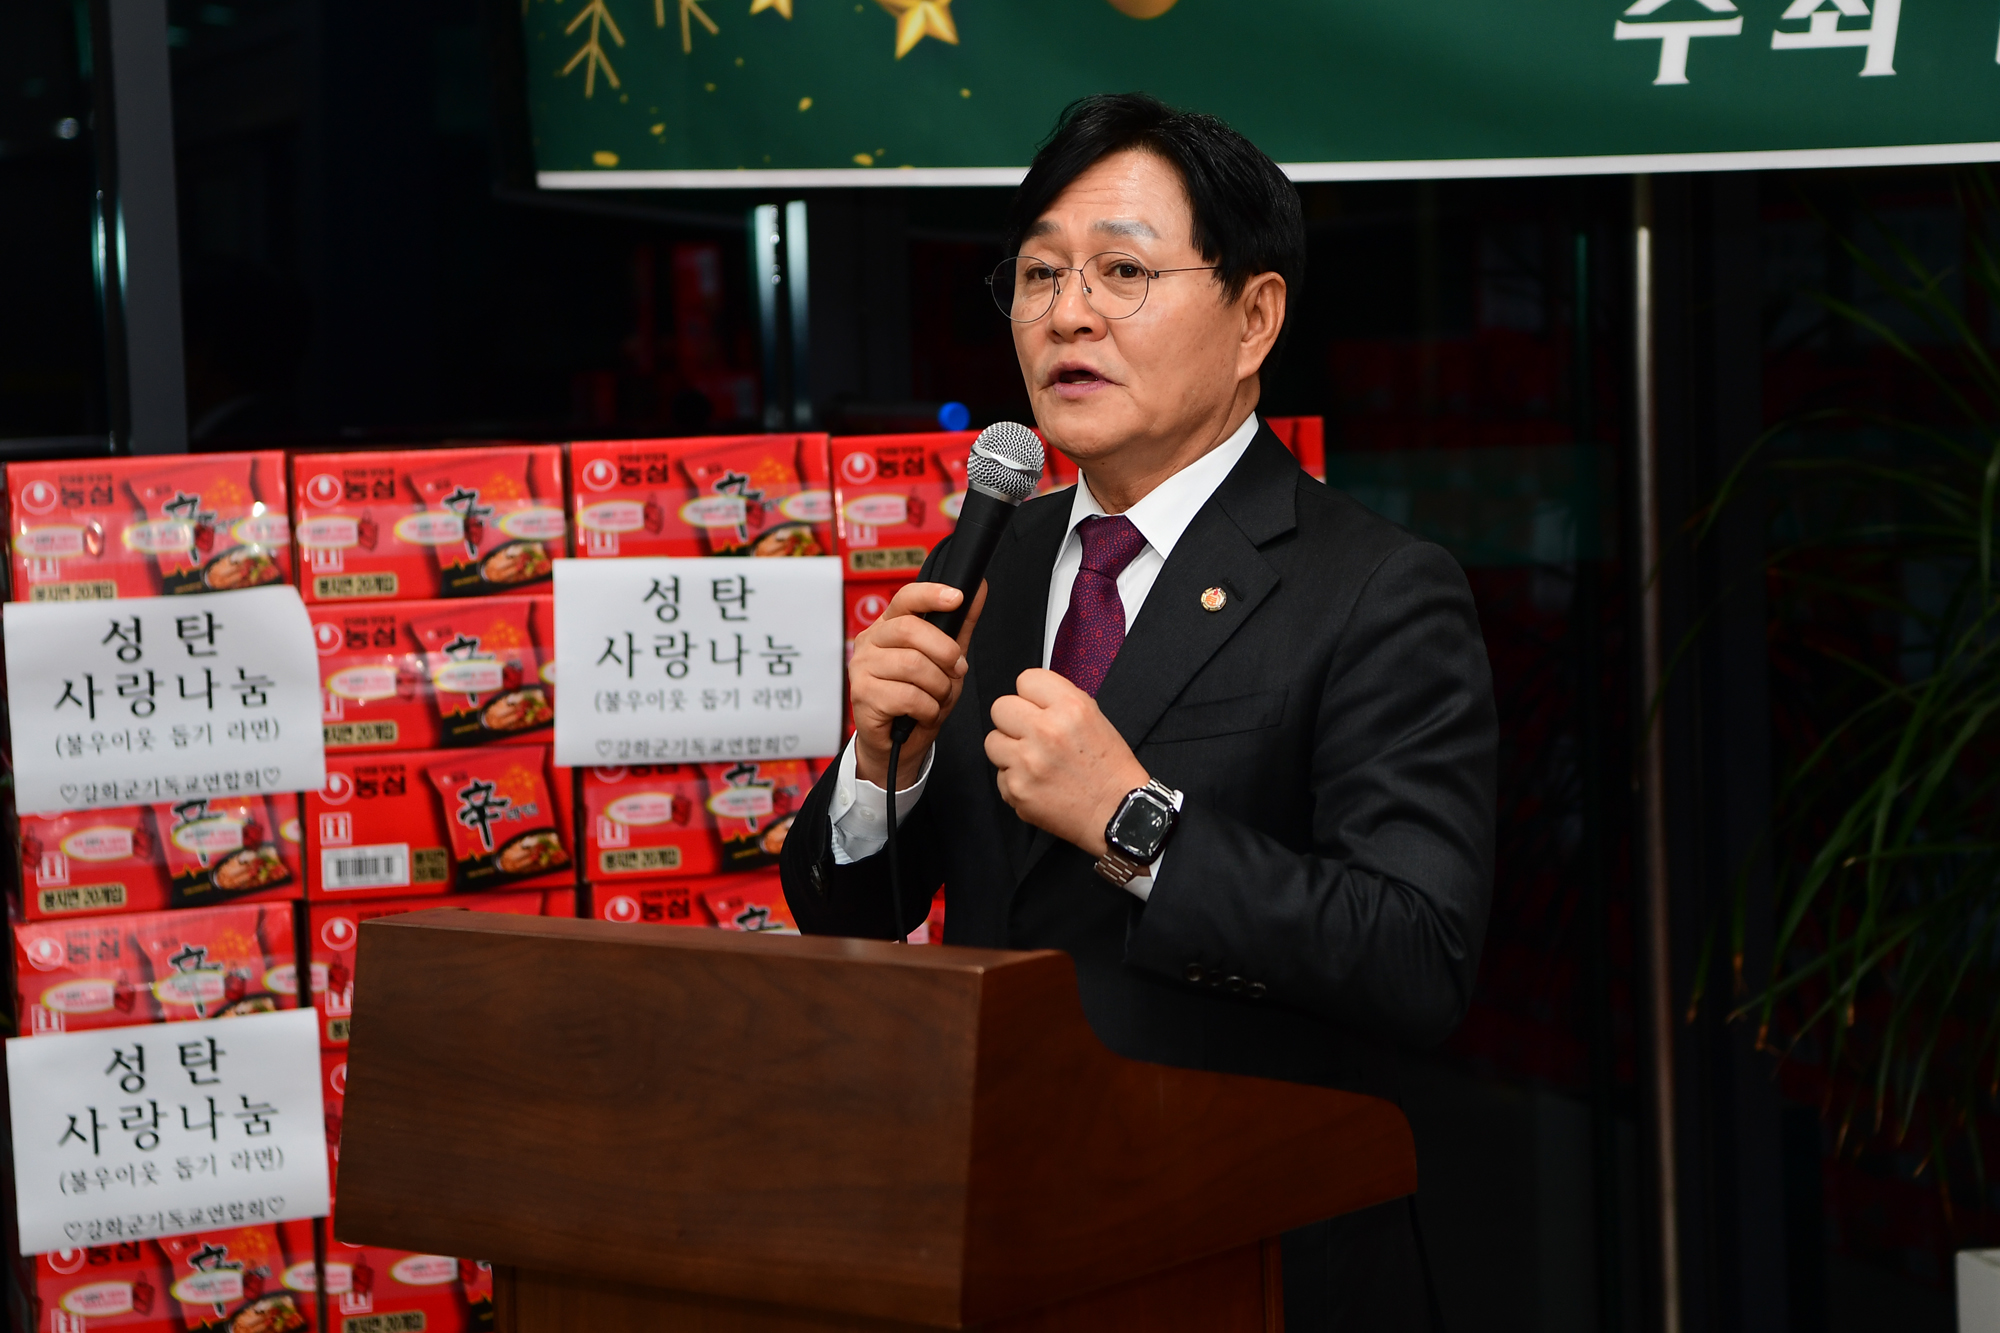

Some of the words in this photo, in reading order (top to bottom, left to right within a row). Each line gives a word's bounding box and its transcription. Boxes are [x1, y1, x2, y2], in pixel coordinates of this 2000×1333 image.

[596, 630, 801, 679] 사랑나눔
[54, 666, 275, 721] 사랑나눔
[753, 689, 803, 711] 라면)
[227, 717, 280, 743] 라면)
[355, 775, 407, 799] 농심
[457, 777, 511, 852] 辛
[58, 1095, 278, 1157] 사랑나눔
[231, 1146, 285, 1173] 라면)
